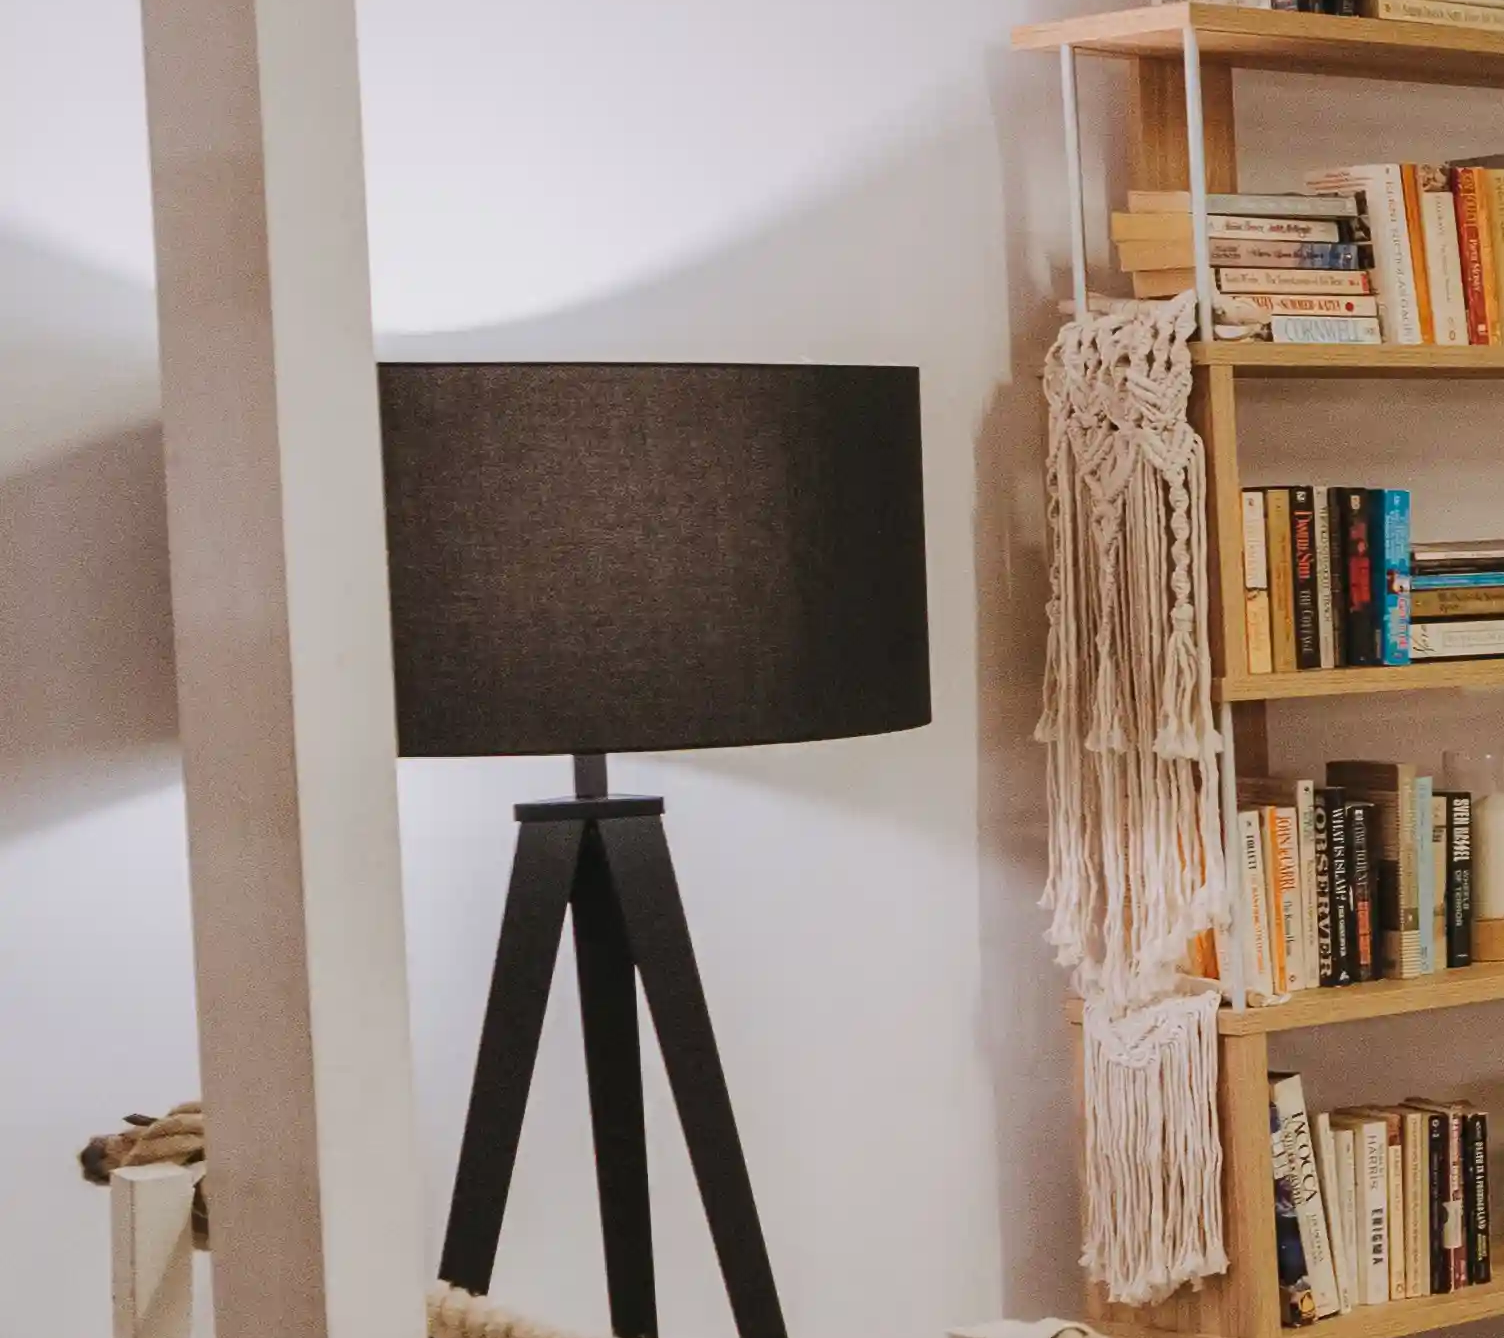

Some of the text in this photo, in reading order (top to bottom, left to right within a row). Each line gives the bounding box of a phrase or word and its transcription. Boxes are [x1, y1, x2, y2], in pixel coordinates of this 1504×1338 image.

[1332, 808, 1345, 844] WHAT
[1453, 798, 1469, 825] SVEN
[1276, 816, 1295, 846] JOHN
[1333, 845, 1345, 857] IS
[1315, 807, 1332, 977] OBSERVER
[1291, 1110, 1318, 1202] IACOCCA
[1367, 1134, 1378, 1190] HARRIS
